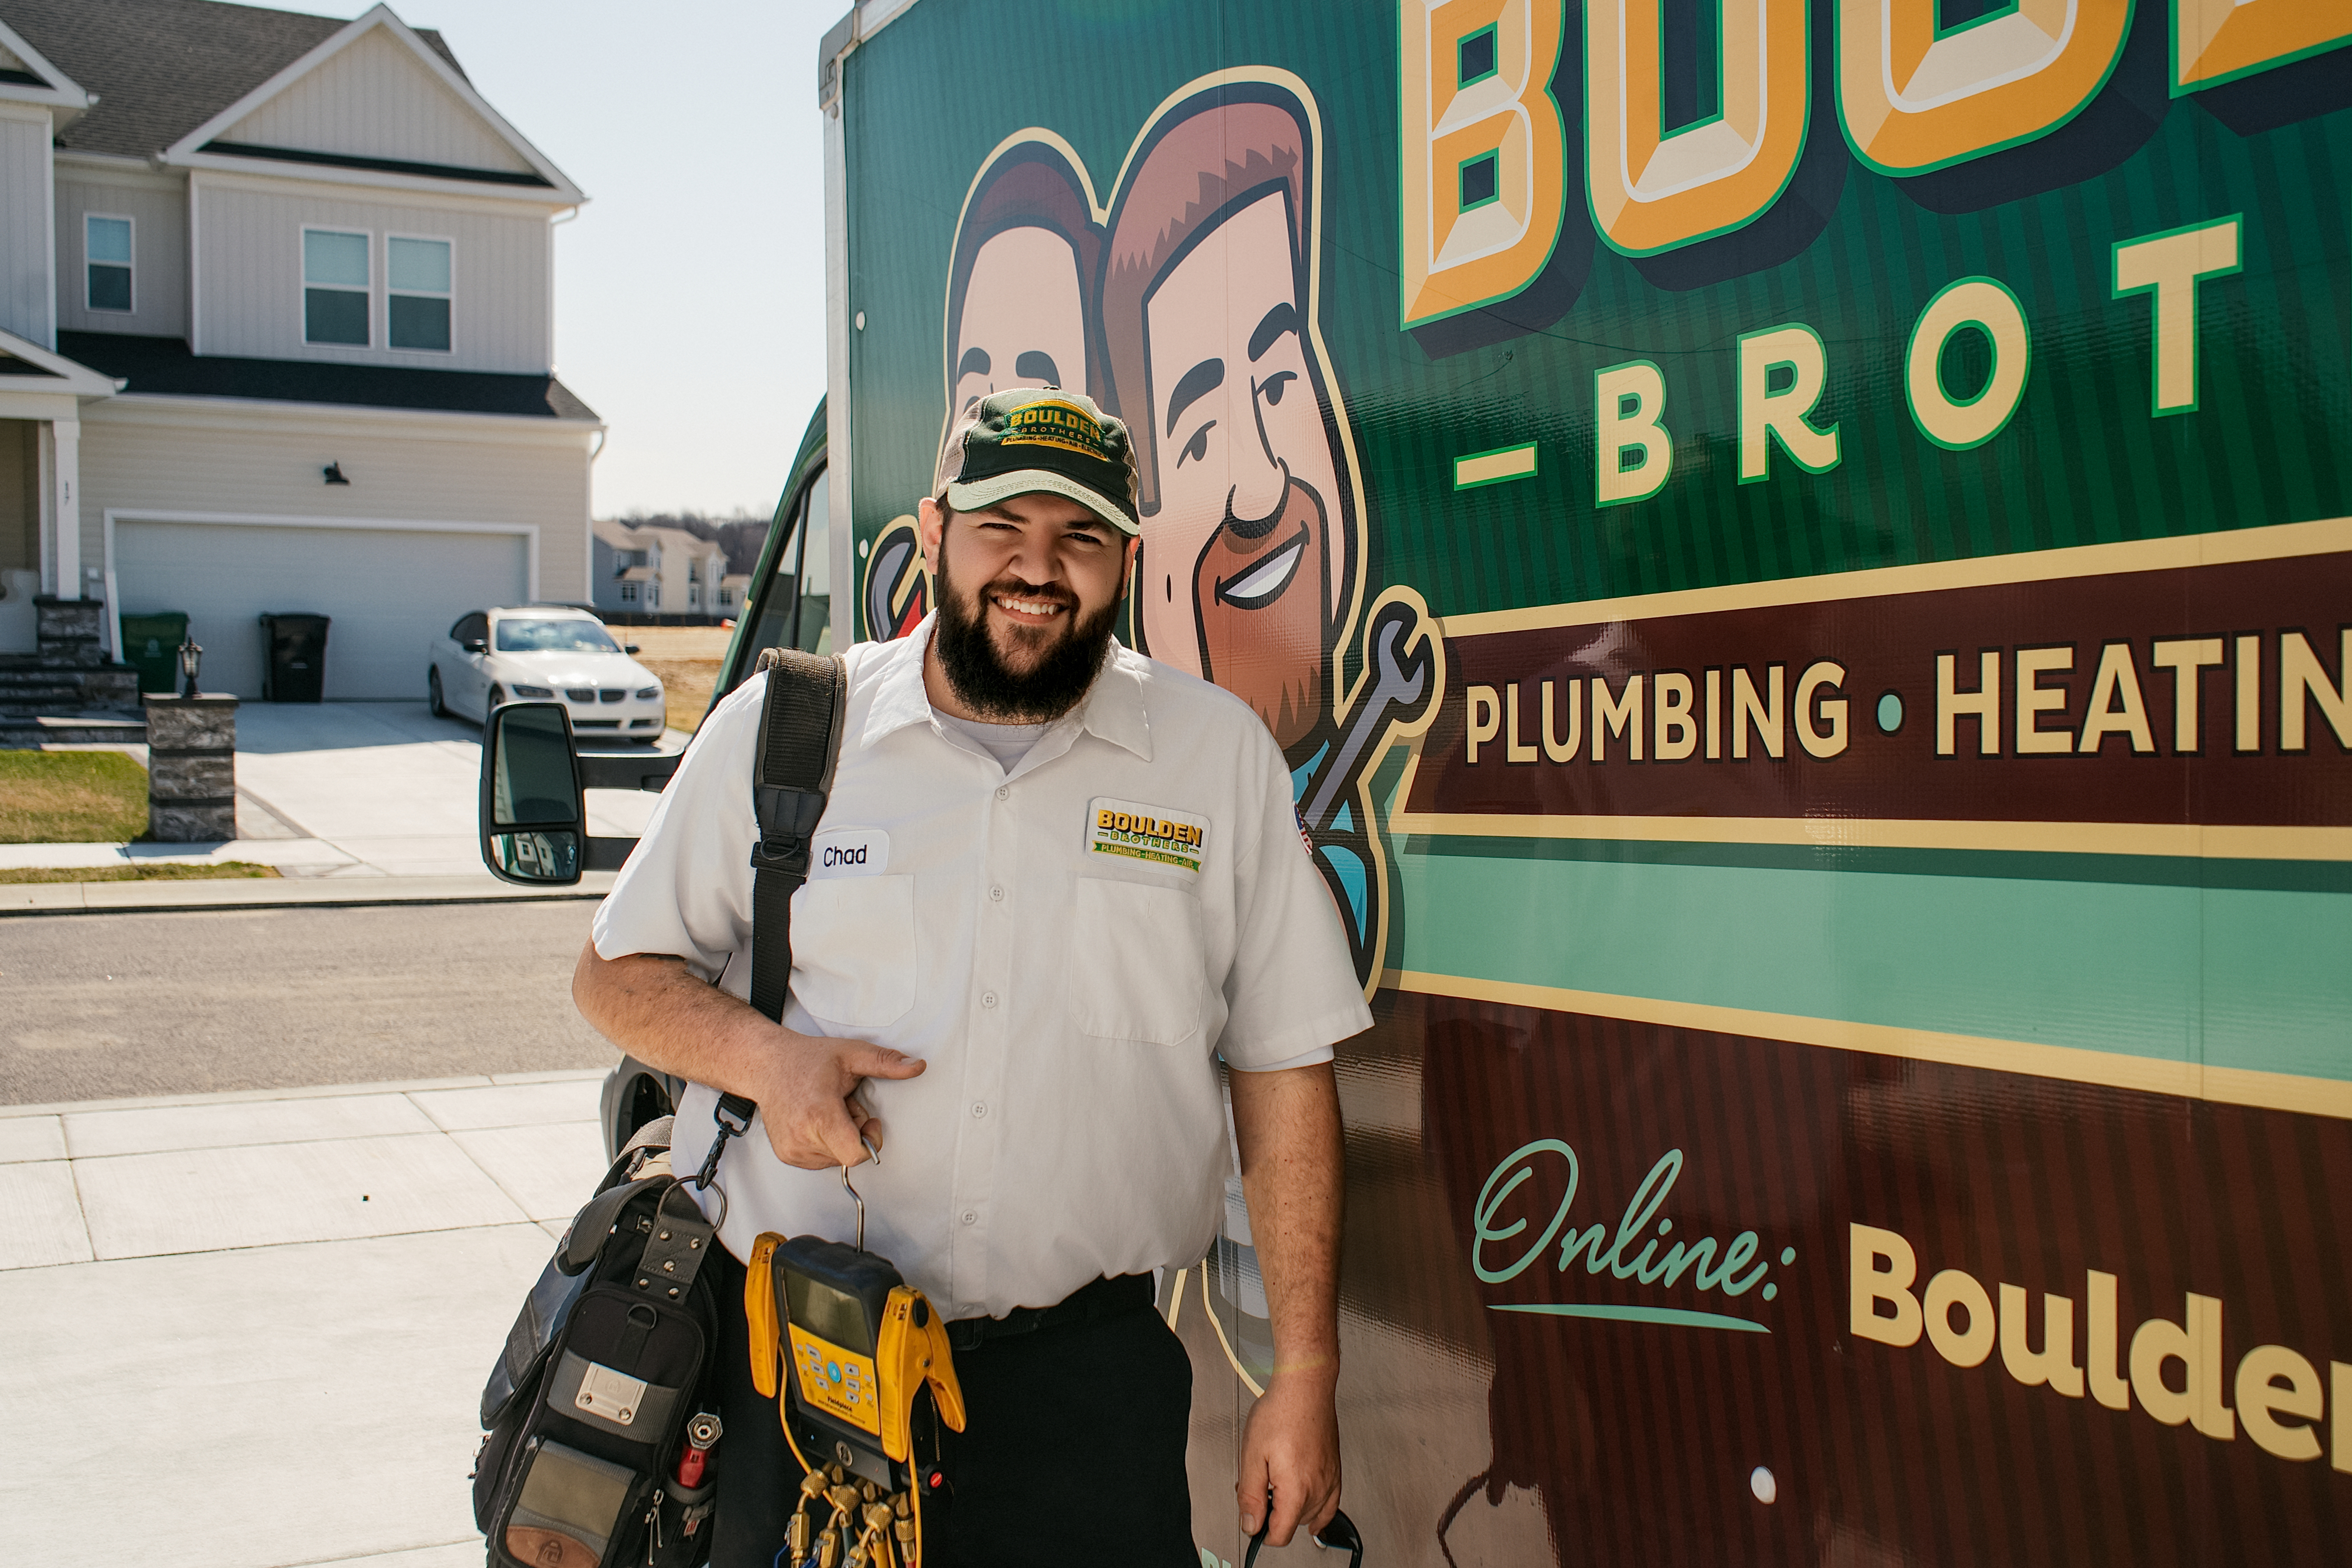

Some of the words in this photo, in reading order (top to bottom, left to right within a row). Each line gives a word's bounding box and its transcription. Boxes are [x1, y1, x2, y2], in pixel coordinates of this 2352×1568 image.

[1010, 409, 1102, 442] BOULDEN
[1021, 427, 1090, 444] BROTHERS
[1465, 660, 1849, 765] PLUMBING
[1935, 628, 2352, 756] HEATIN
[1097, 809, 1203, 848] BOULDEN
[1110, 830, 1189, 853] BROTHERS
[824, 844, 867, 867] Chad
[1472, 1138, 1796, 1302] Online:
